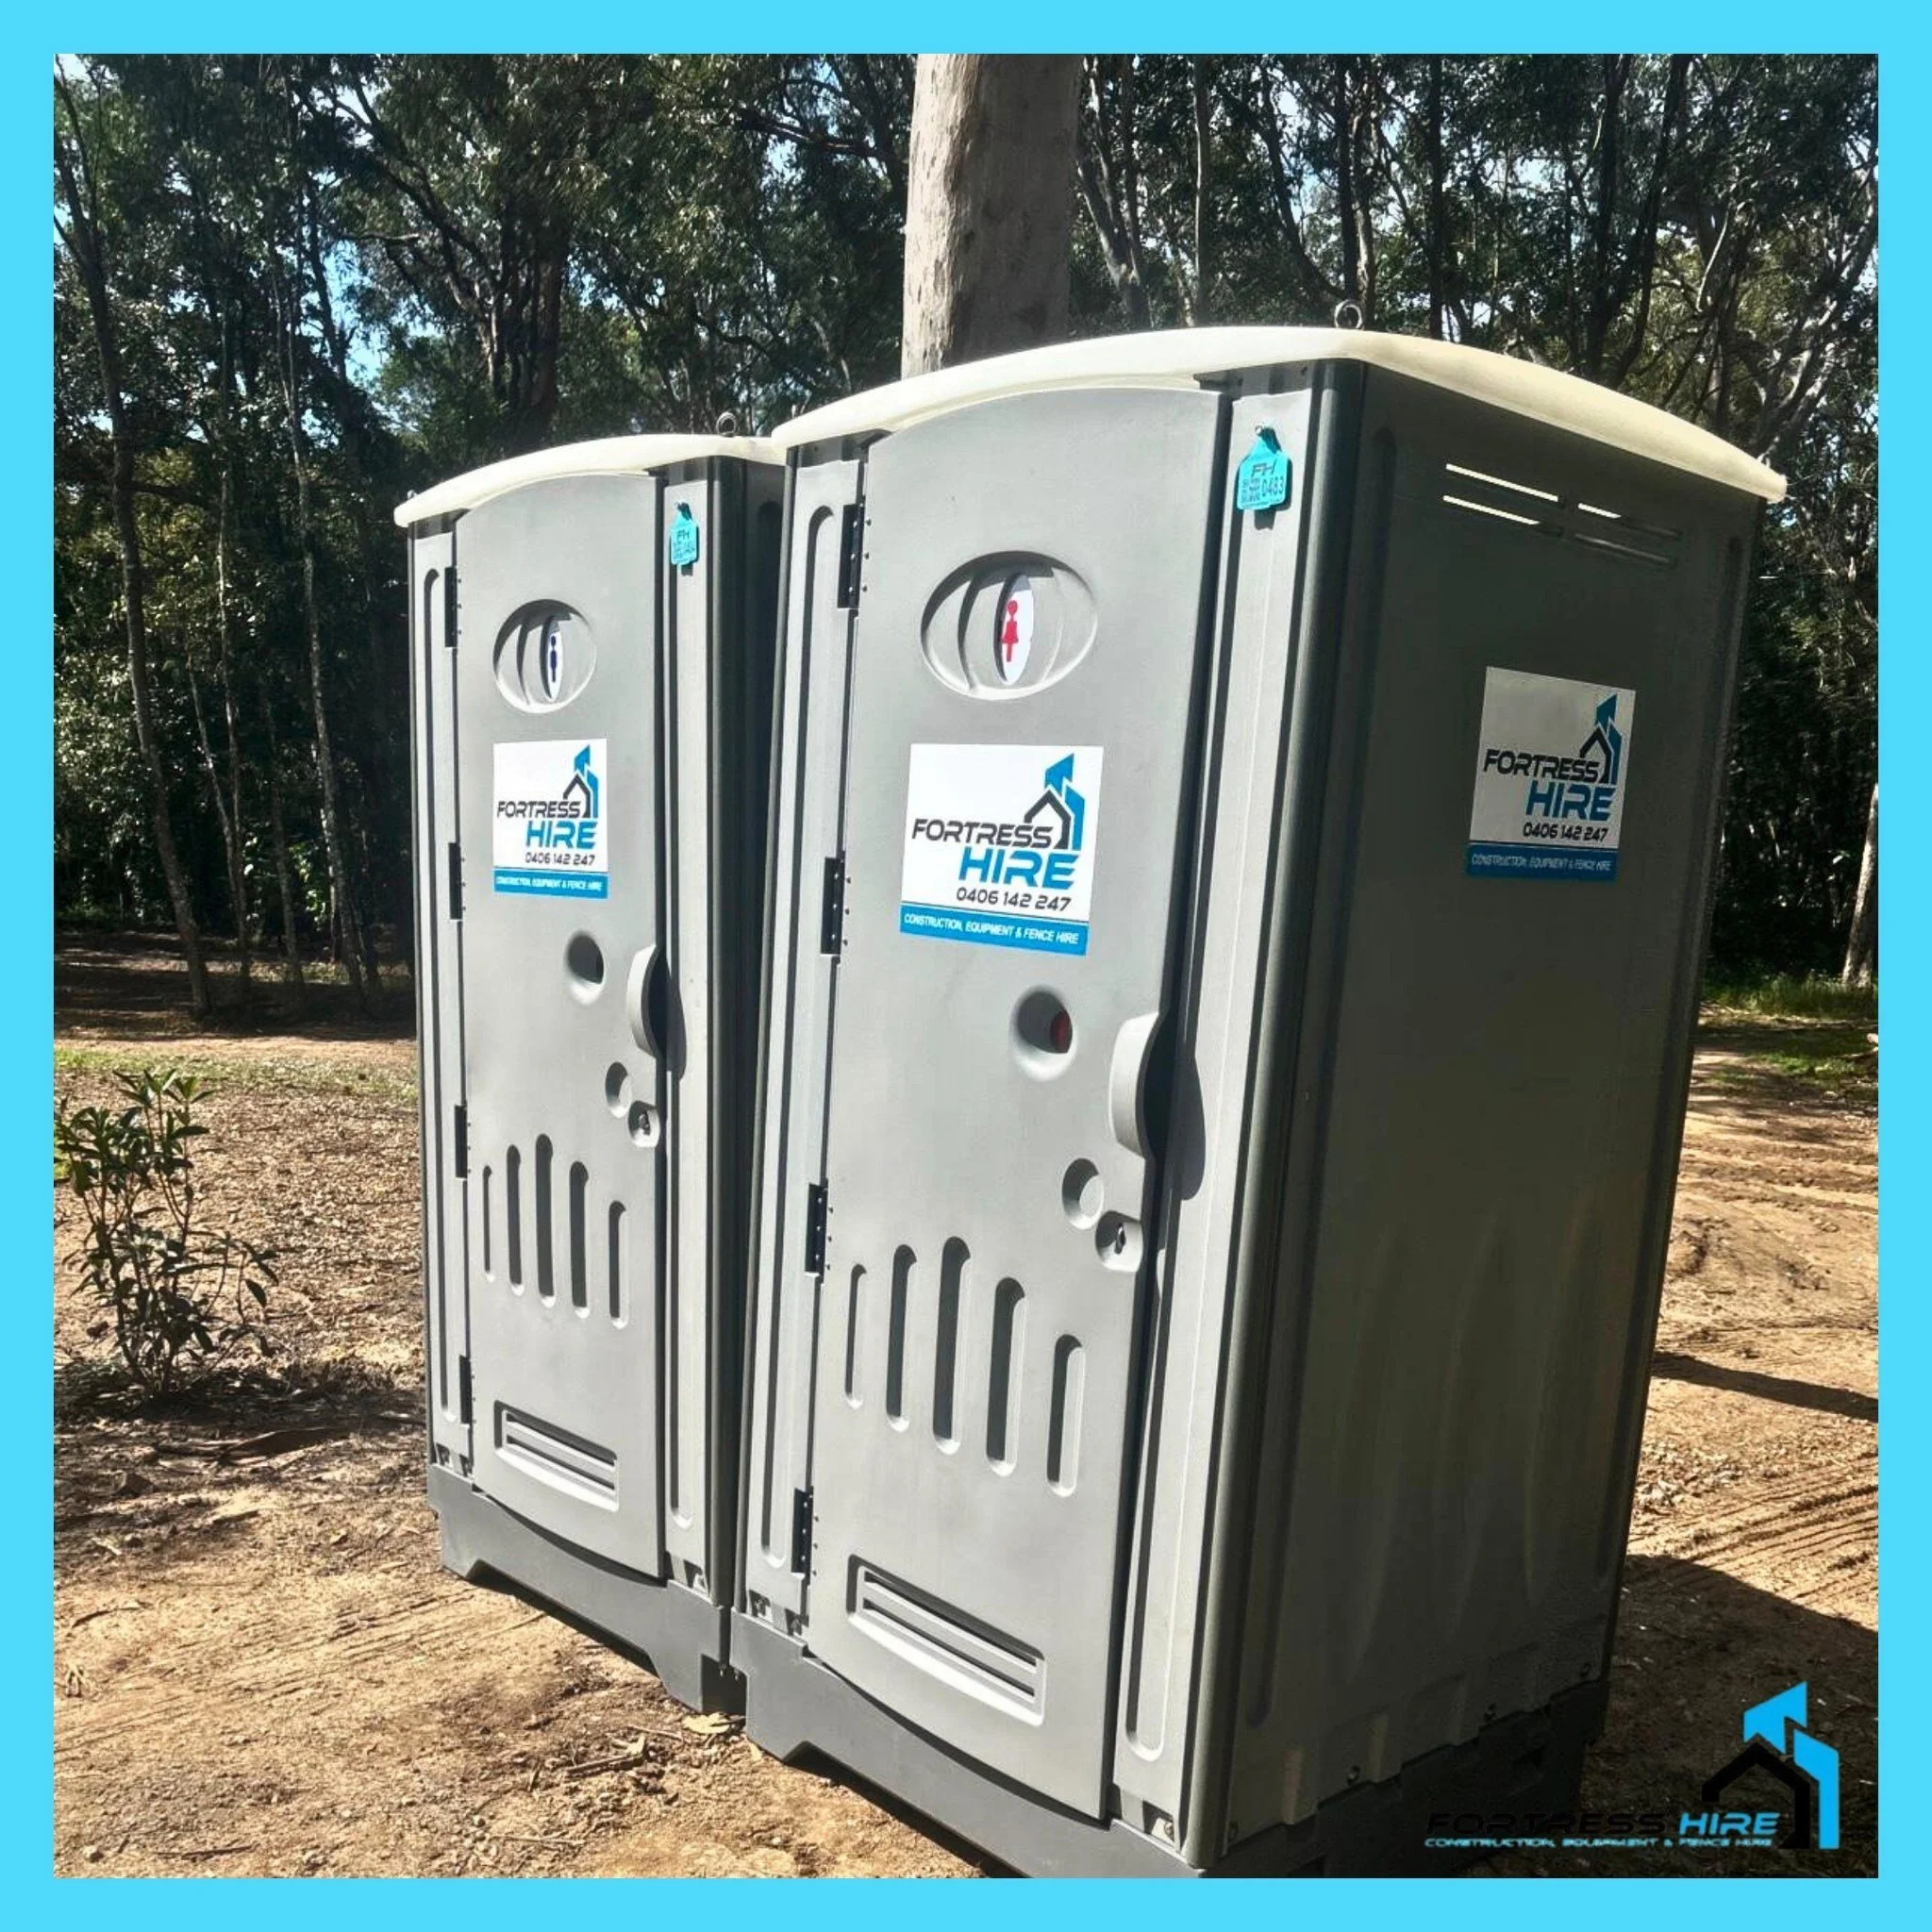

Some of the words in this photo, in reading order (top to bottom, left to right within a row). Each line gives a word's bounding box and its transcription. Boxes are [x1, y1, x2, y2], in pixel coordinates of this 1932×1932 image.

[1483, 748, 1600, 783] FORTRESS
[497, 800, 581, 819] FORTRESS
[1525, 779, 1616, 822] HIRE
[525, 820, 598, 850] HIRE
[911, 818, 1054, 849] FORTRESS
[1523, 822, 1558, 840] 0406
[1561, 824, 1582, 840] 142
[1585, 826, 1608, 841] 247
[525, 851, 551, 864] 0406
[553, 854, 571, 865] 142
[573, 854, 595, 866] 247
[958, 845, 1079, 891] HIRE
[956, 887, 999, 905] 0406
[1004, 891, 1031, 908] 142
[1035, 894, 1072, 912] 247
[965, 920, 1015, 939] EQUIPMENT
[1015, 925, 1023, 939] &
[1024, 926, 1055, 942] FENCE
[1056, 930, 1079, 944] HIRE
